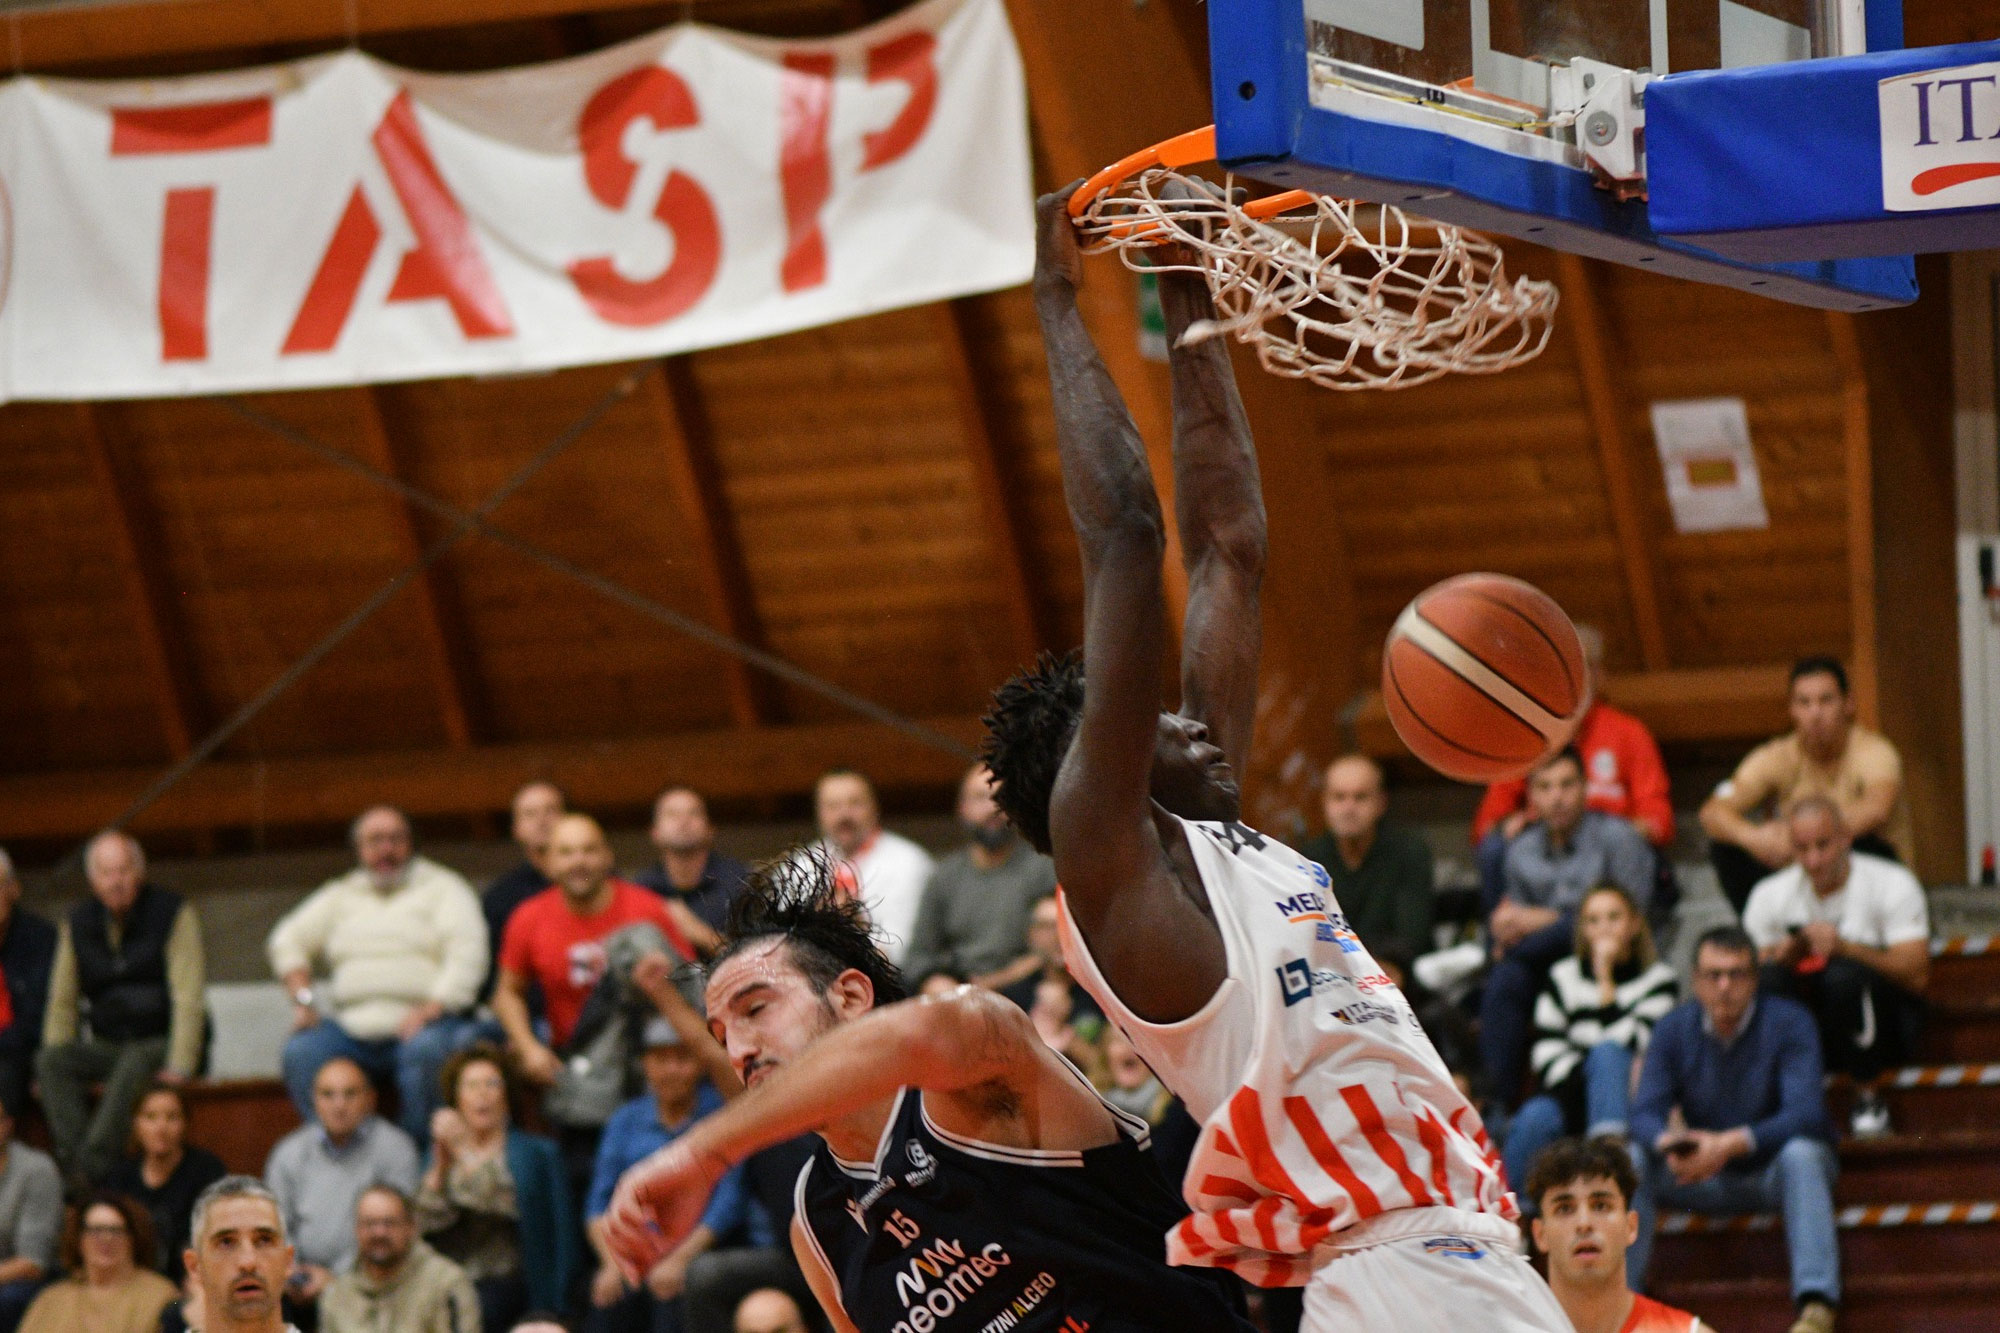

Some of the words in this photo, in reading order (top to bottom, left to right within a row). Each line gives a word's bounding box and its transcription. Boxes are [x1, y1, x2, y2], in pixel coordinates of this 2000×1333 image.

[1911, 74, 2000, 146] IT
[883, 1208, 920, 1249] 15
[891, 1242, 1011, 1333] neomec
[1012, 1271, 1056, 1318] ALCEO
